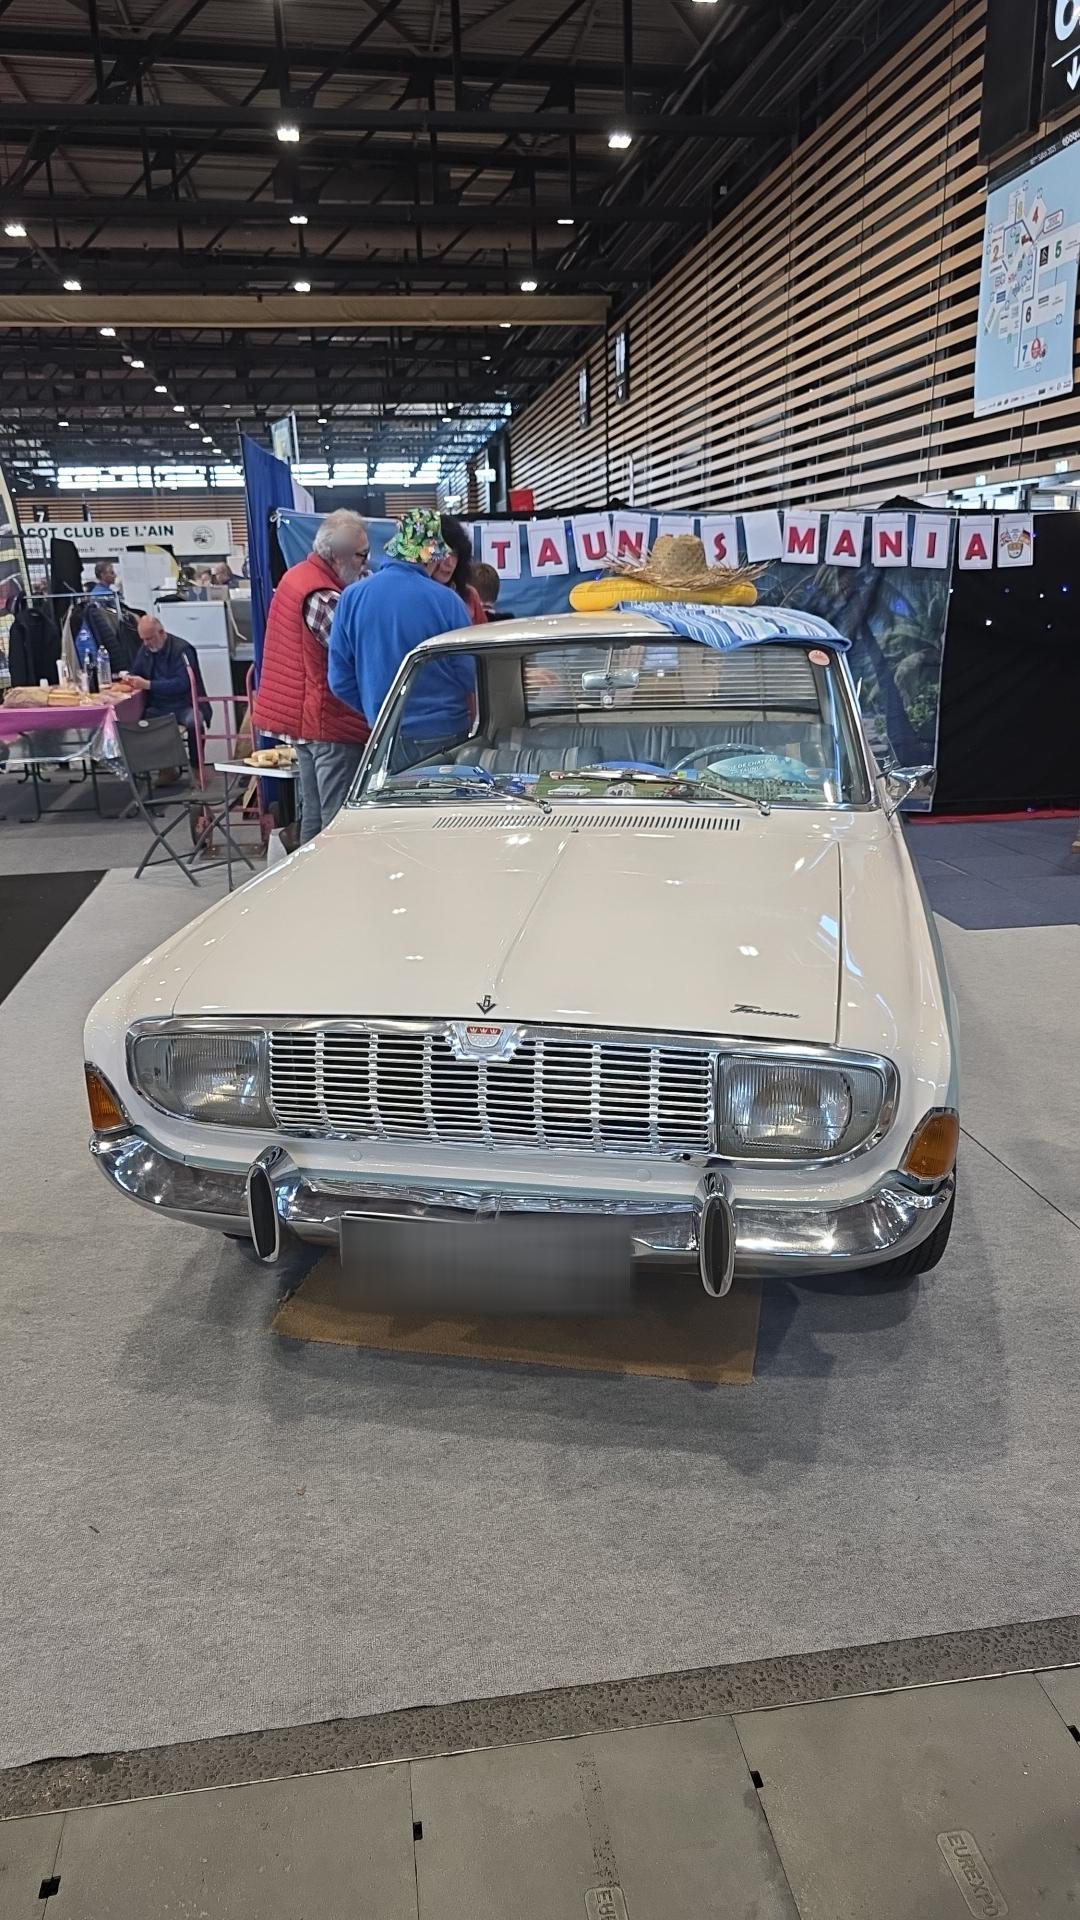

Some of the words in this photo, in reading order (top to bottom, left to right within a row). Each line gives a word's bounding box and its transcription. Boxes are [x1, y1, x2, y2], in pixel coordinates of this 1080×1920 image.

[1032, 206, 1039, 224] 4
[992, 244, 1000, 263] 2
[1025, 306, 1032, 323] 6
[1021, 344, 1028, 361] 7
[64, 526, 104, 538] CLUB
[110, 526, 129, 537] DE
[491, 529, 727, 569] TAUNS
[947, 1834, 999, 1917] EUREXPO
